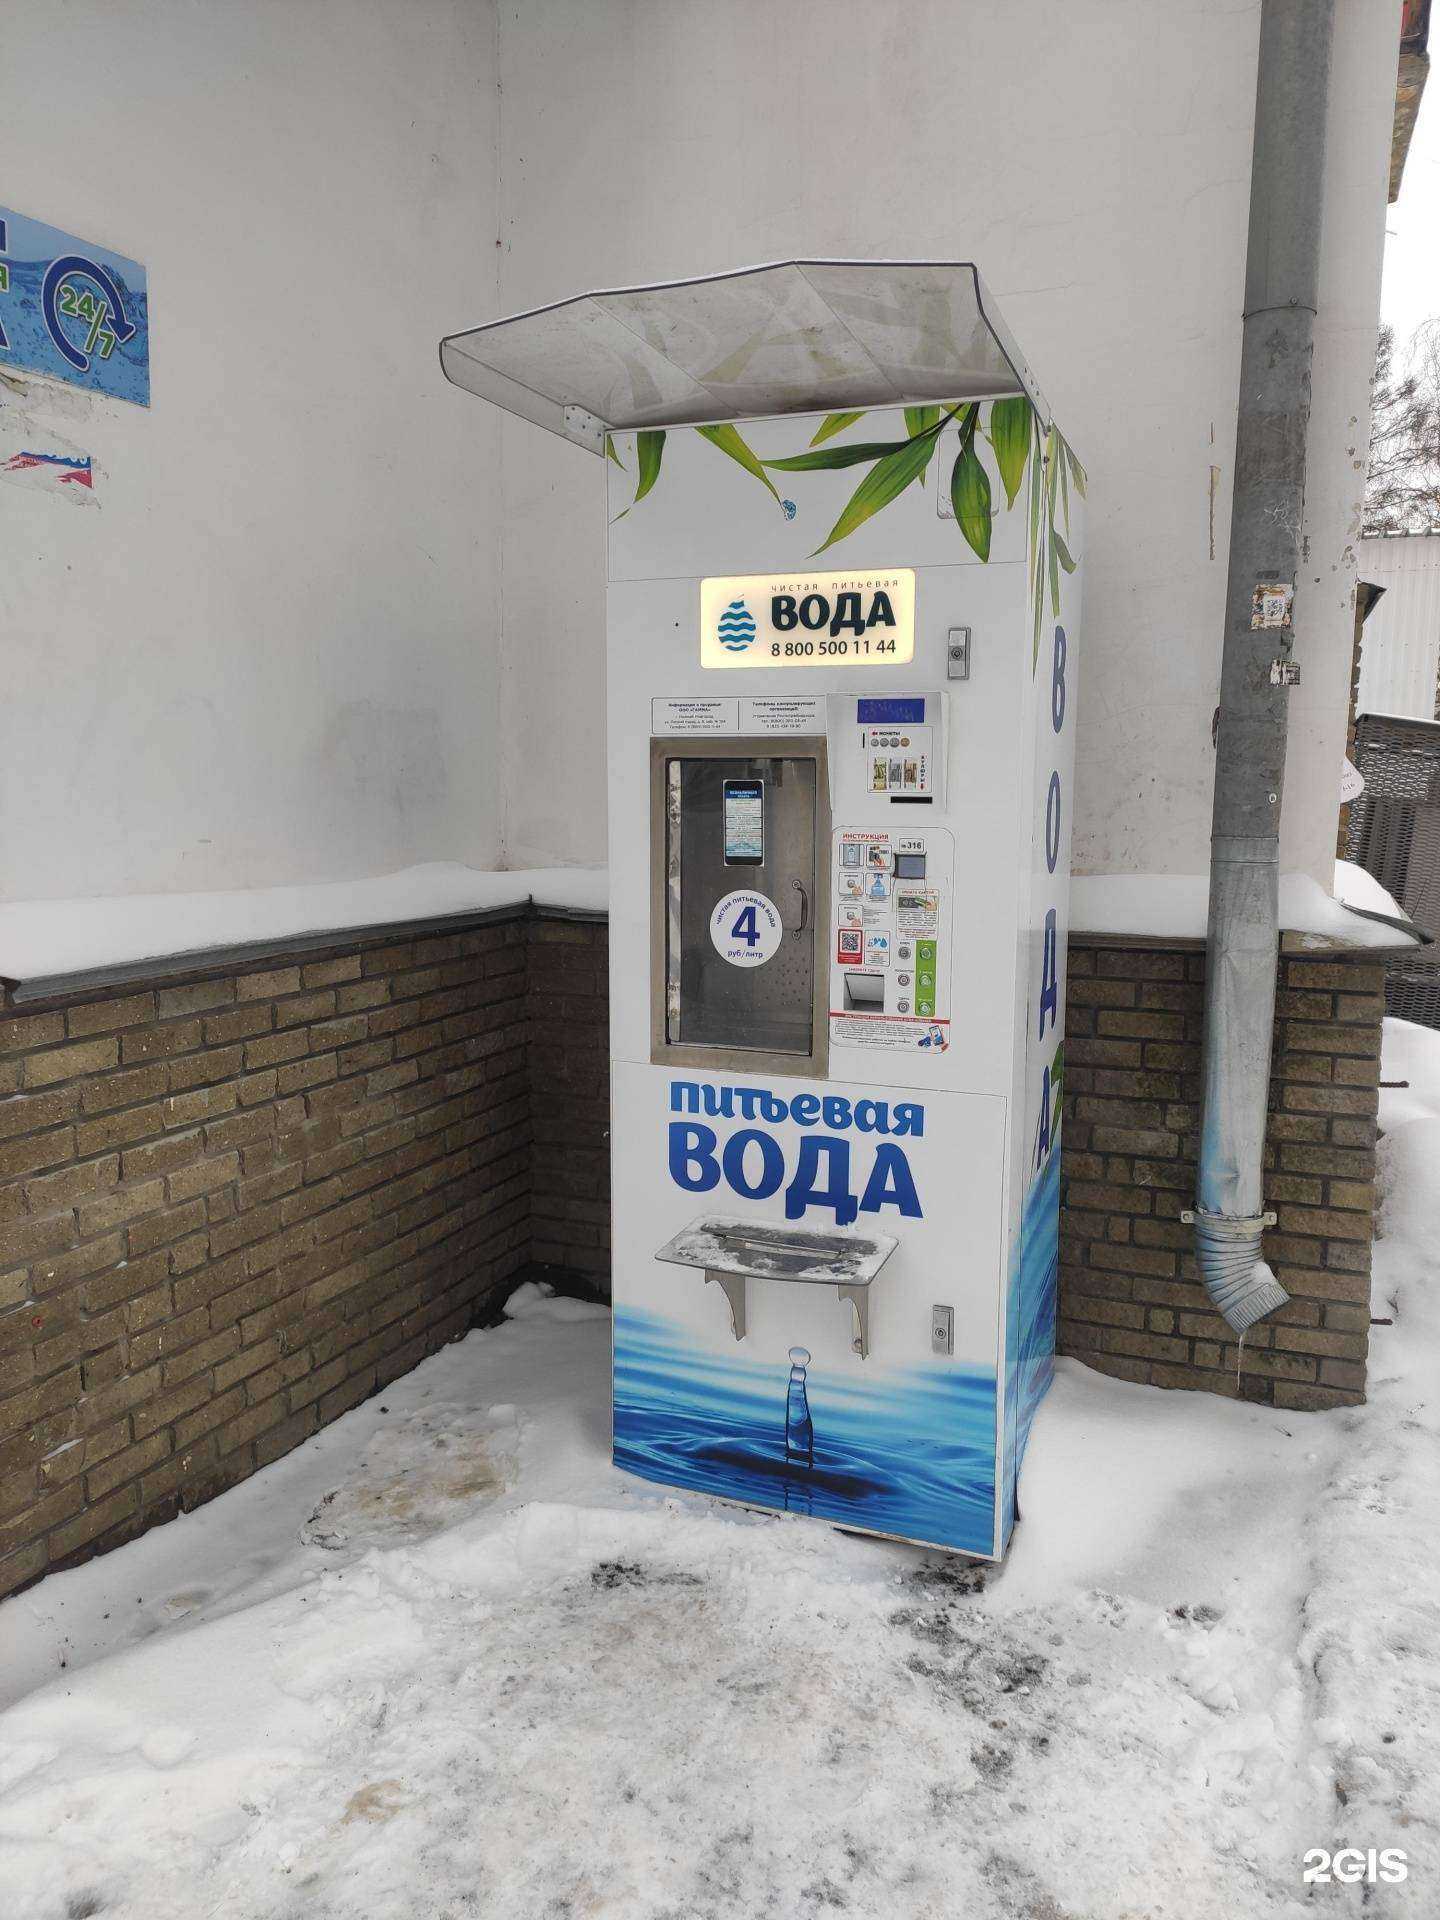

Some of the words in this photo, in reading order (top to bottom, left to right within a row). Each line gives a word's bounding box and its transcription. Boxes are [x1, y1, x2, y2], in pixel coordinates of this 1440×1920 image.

[59, 284, 116, 360] 24/7
[771, 582, 818, 592] чистая
[832, 579, 899, 590] питьевая
[771, 590, 897, 637] ВОДА
[771, 643, 781, 656] 8
[784, 642, 814, 656] 800
[818, 640, 848, 655] 500
[854, 640, 869, 654] 11
[876, 639, 896, 653] 44
[842, 833, 889, 841] ИНСТРУКЦИЯ
[907, 841, 922, 849] 316
[716, 900, 733, 926] чистая
[732, 896, 766, 910] питьевая
[765, 908, 777, 928] вода
[731, 906, 761, 947] 4
[727, 949, 764, 960] руб/литр
[670, 1081, 925, 1137] питьевая
[668, 1121, 924, 1226] ВОДА
